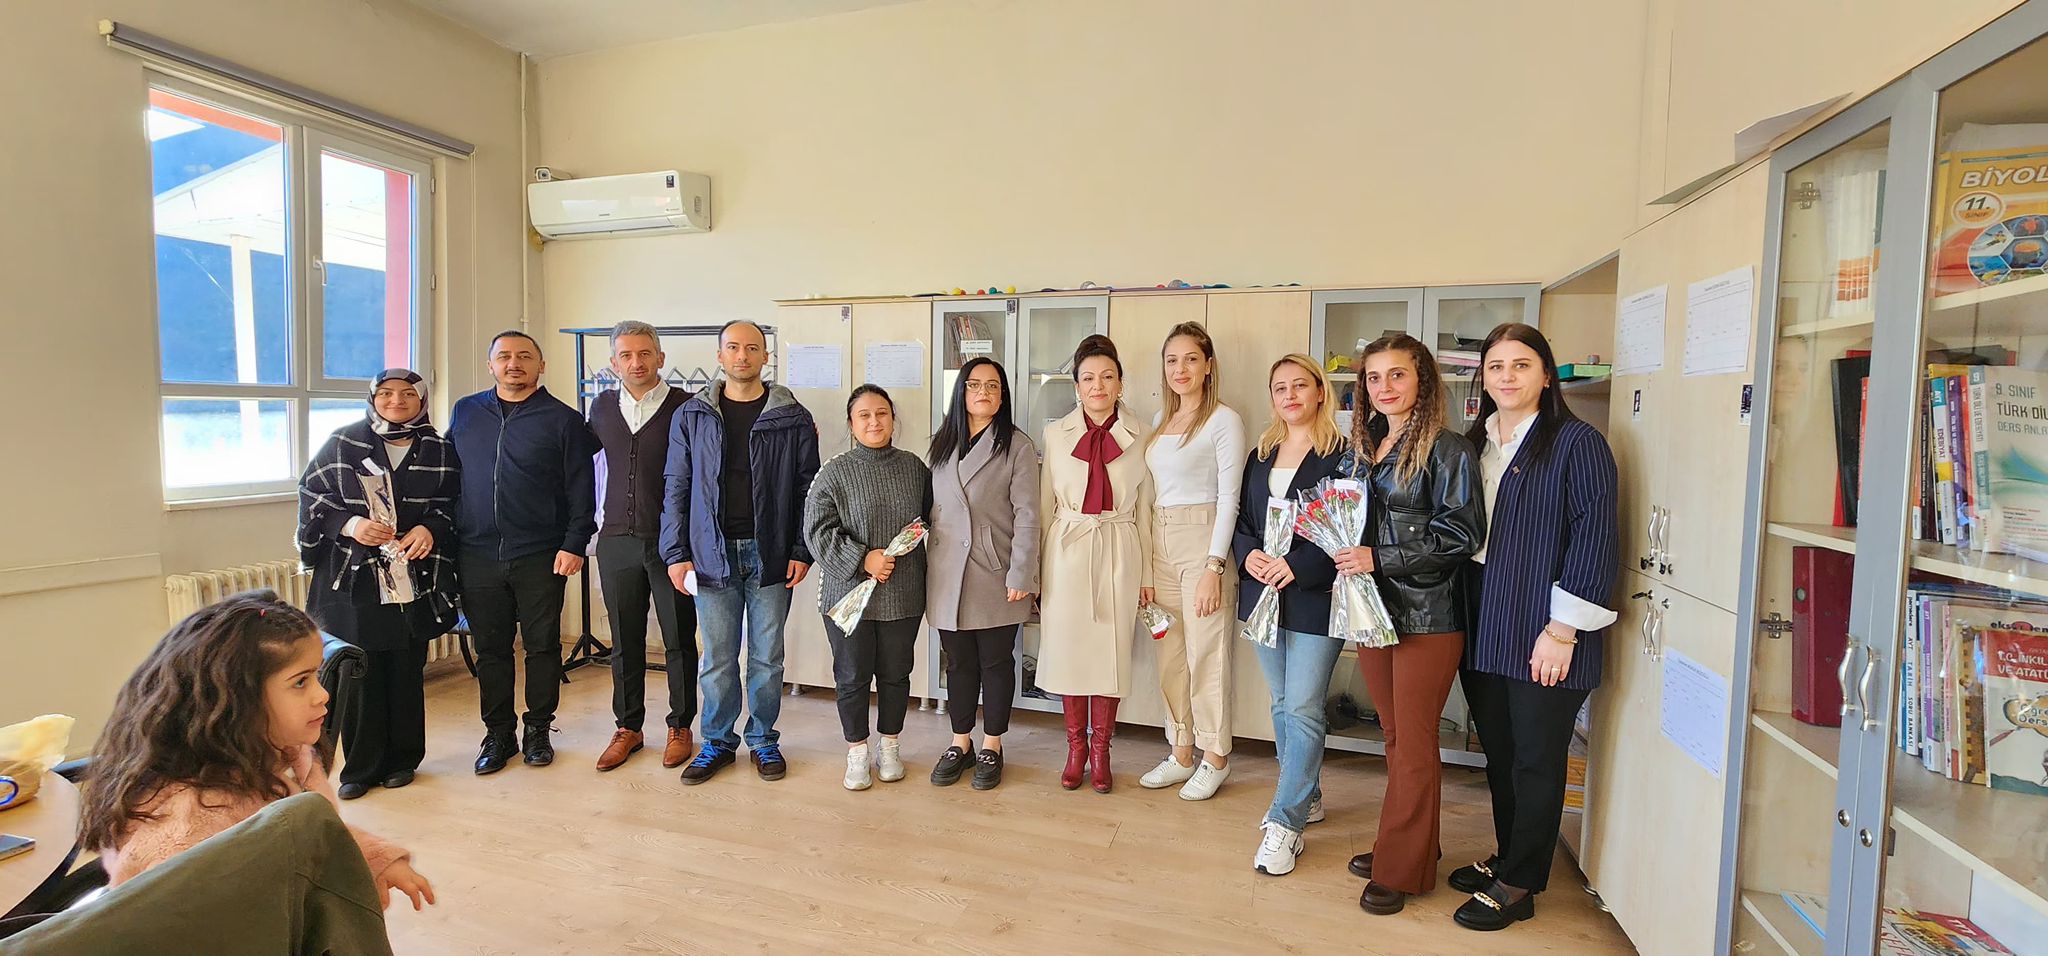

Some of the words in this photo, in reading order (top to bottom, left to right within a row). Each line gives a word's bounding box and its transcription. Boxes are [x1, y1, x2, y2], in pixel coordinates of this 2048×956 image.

[1965, 196, 1991, 211] 11.
[2008, 384, 2037, 399] SINIF
[1996, 401, 2028, 418] TÜRK
[1997, 421, 2022, 433] DERS
[1937, 429, 1945, 458] EDEBİYAT
[1997, 665, 2013, 675] VE
